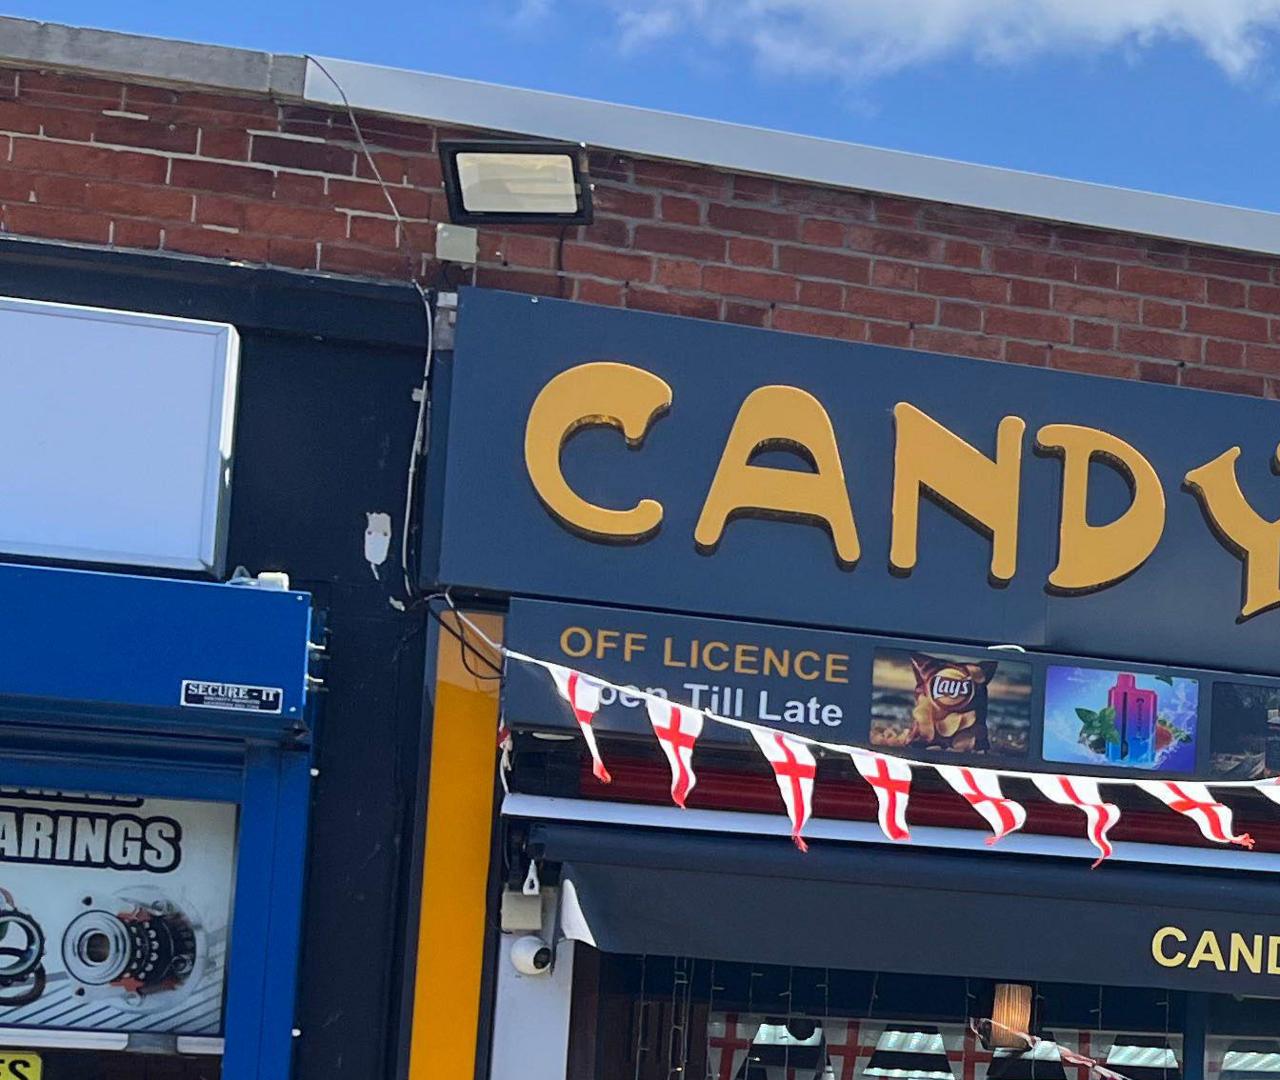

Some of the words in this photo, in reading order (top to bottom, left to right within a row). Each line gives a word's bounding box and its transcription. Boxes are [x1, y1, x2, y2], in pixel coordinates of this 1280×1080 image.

[559, 626, 647, 662] OFF
[664, 637, 849, 684] LICENCE
[188, 683, 249, 699] SECURE
[683, 682, 743, 719] Till
[759, 690, 843, 728] Late
